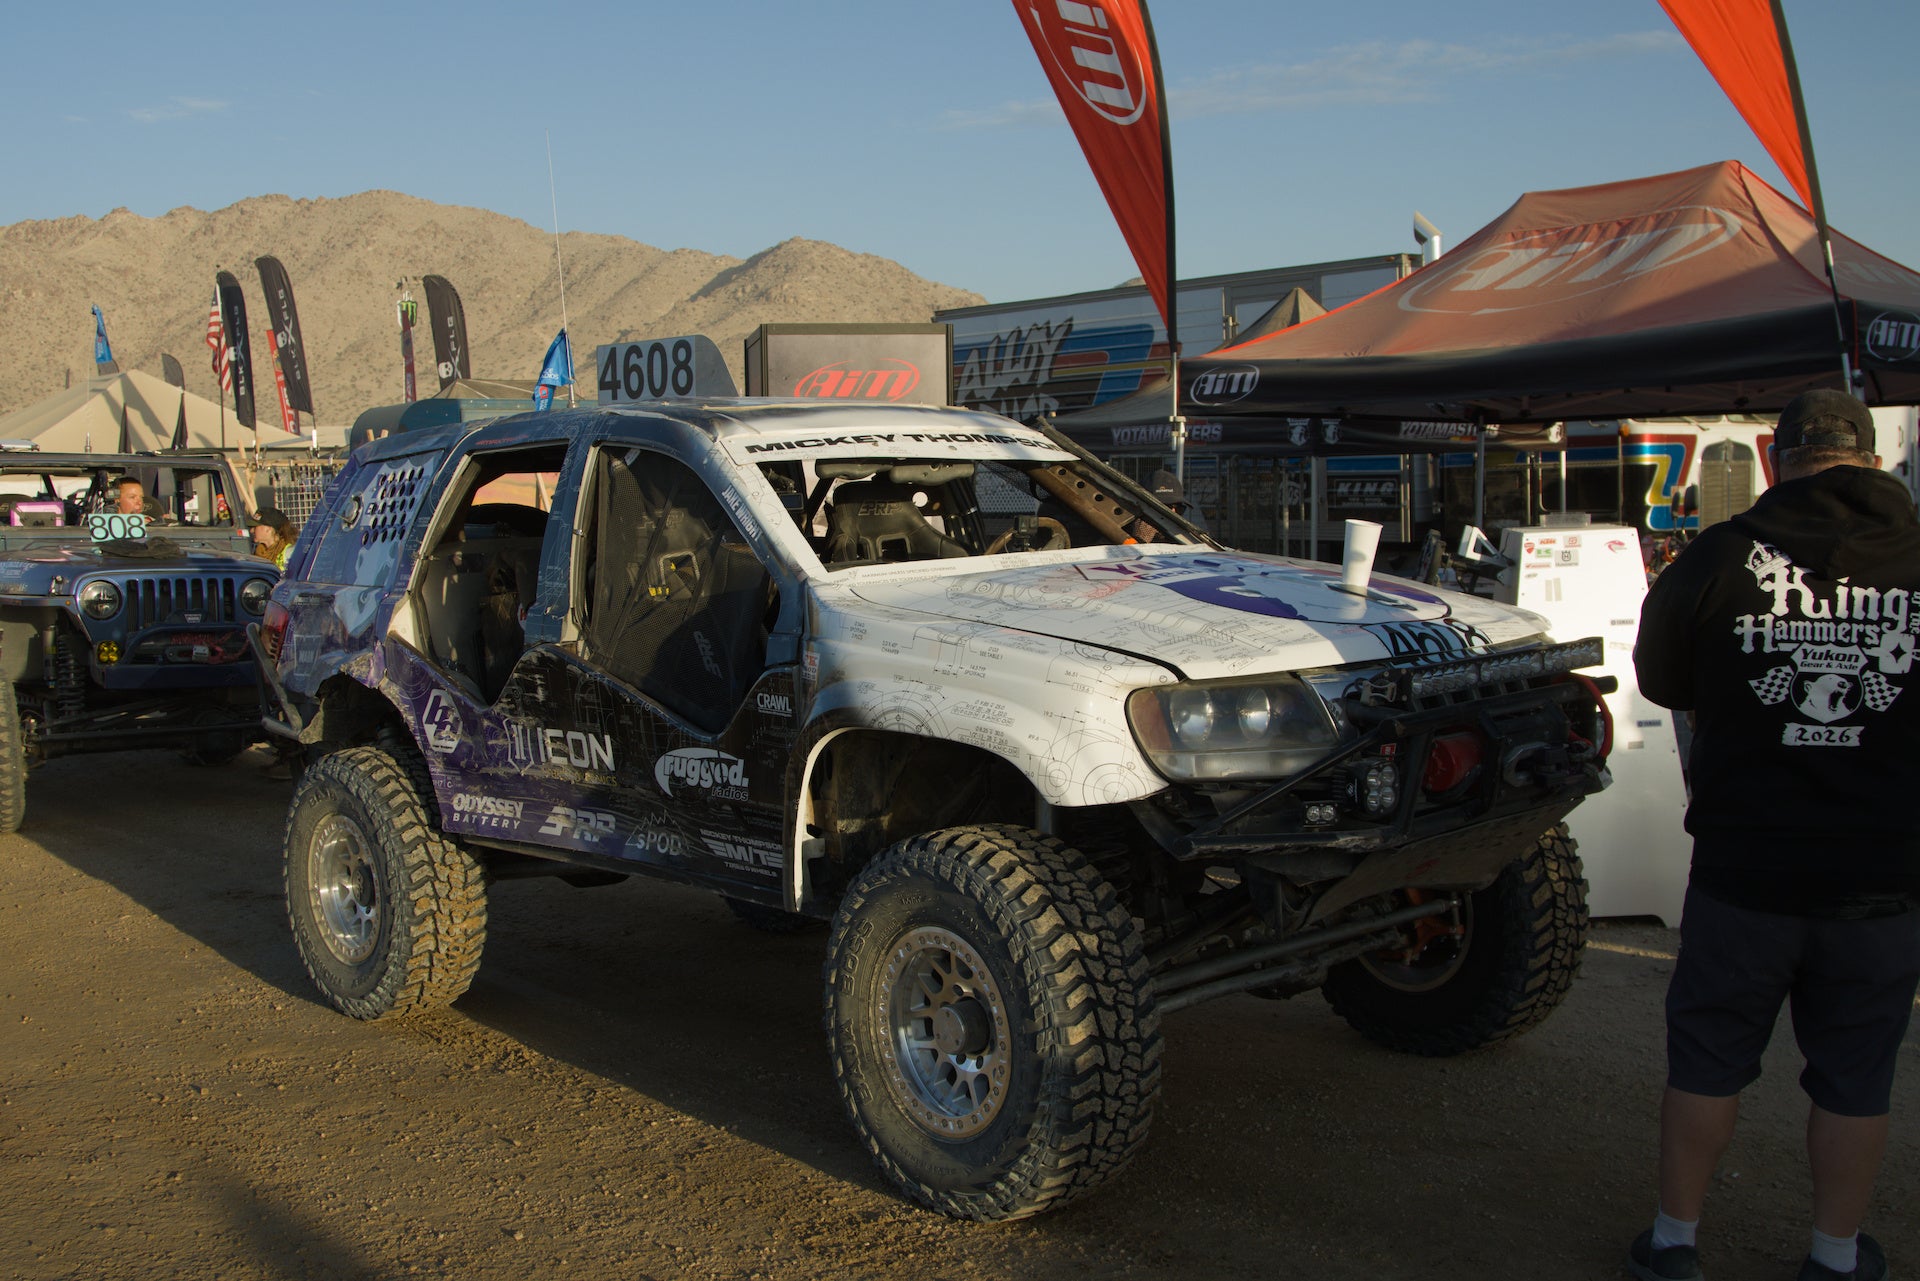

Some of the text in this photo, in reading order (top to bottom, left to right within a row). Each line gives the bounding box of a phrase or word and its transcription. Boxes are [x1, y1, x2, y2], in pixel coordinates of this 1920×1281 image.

[447, 316, 457, 352] FLG
[600, 339, 693, 400] 4608
[745, 434, 895, 453] MICKEY
[1337, 481, 1395, 496] KING
[722, 485, 763, 541] JAKE WRIGHT
[90, 515, 146, 540] 808
[1760, 565, 1909, 634] King
[1733, 614, 1881, 653] Hammers
[1800, 661, 1823, 669] Gear
[1835, 662, 1859, 671] Axle
[1801, 648, 1860, 663] Yukon
[757, 692, 793, 713] CRAWL
[1794, 727, 1851, 743] 2026
[537, 726, 616, 773] ICON
[711, 786, 749, 801] radios
[452, 793, 524, 819] ODYSSEY
[453, 814, 521, 829] BATTERY
